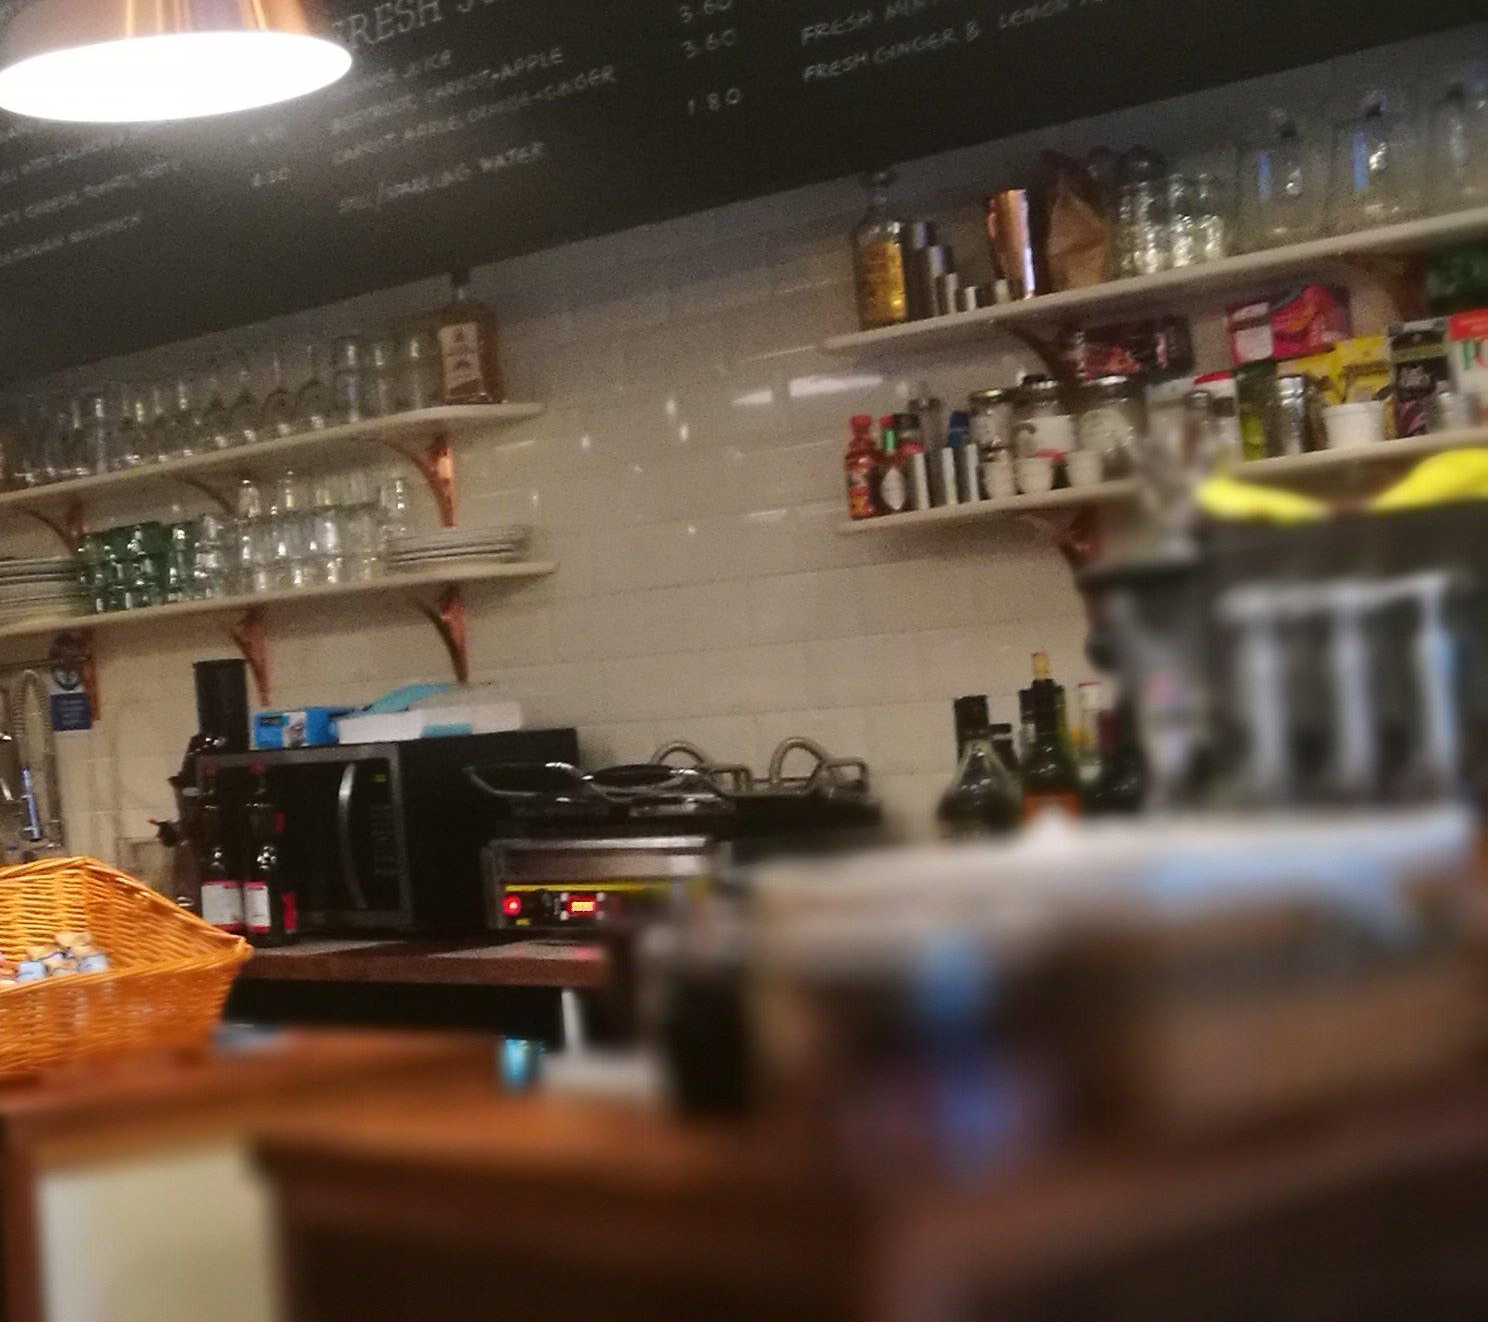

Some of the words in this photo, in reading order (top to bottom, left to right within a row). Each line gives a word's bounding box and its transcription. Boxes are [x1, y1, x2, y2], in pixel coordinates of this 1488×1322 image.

[801, 8, 874, 47] FRESH
[802, 51, 868, 83] FRESH
[873, 27, 959, 66] GINGER
[478, 140, 548, 175] WATER
